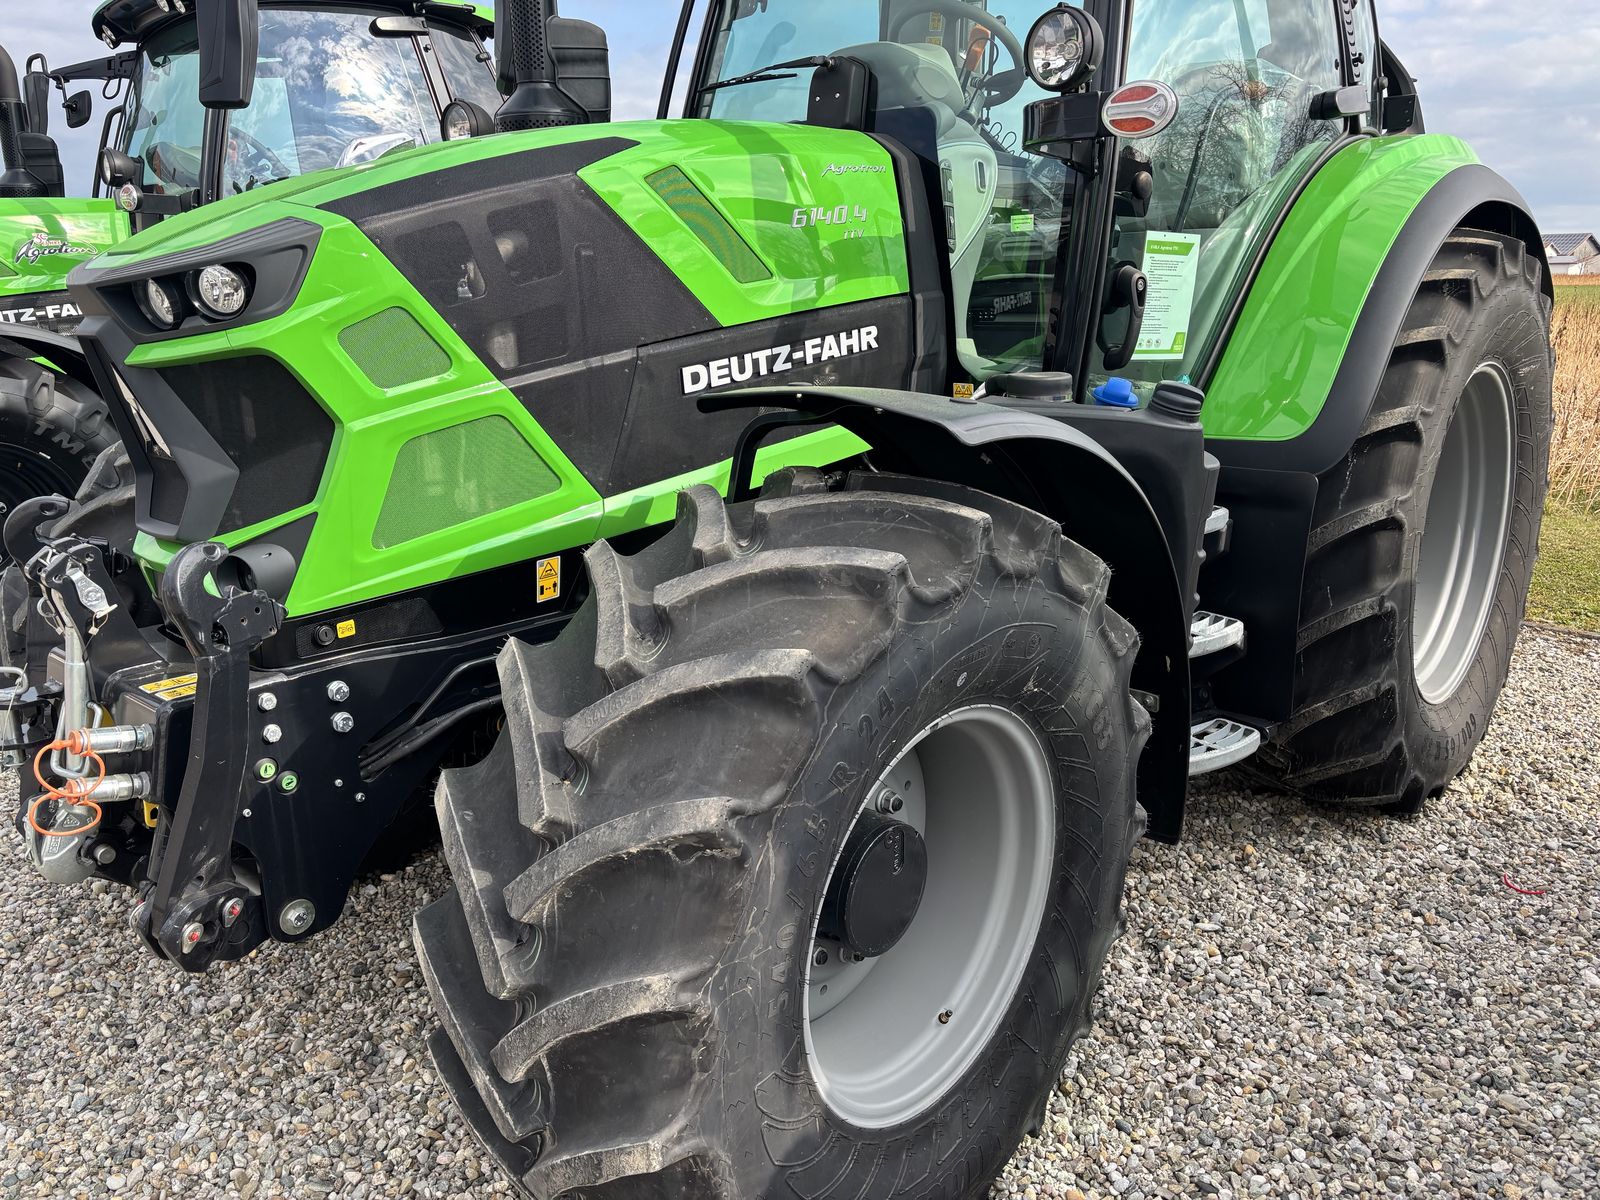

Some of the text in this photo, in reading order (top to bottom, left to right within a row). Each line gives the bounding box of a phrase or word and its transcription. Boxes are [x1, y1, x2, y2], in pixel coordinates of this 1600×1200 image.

[822, 163, 887, 177] Agrotron
[791, 205, 868, 229] 6140.4
[0, 303, 83, 323] TZ-FA
[681, 325, 879, 395] DEUTZ-FAHR
[828, 761, 858, 793] R
[857, 686, 896, 748] 24
